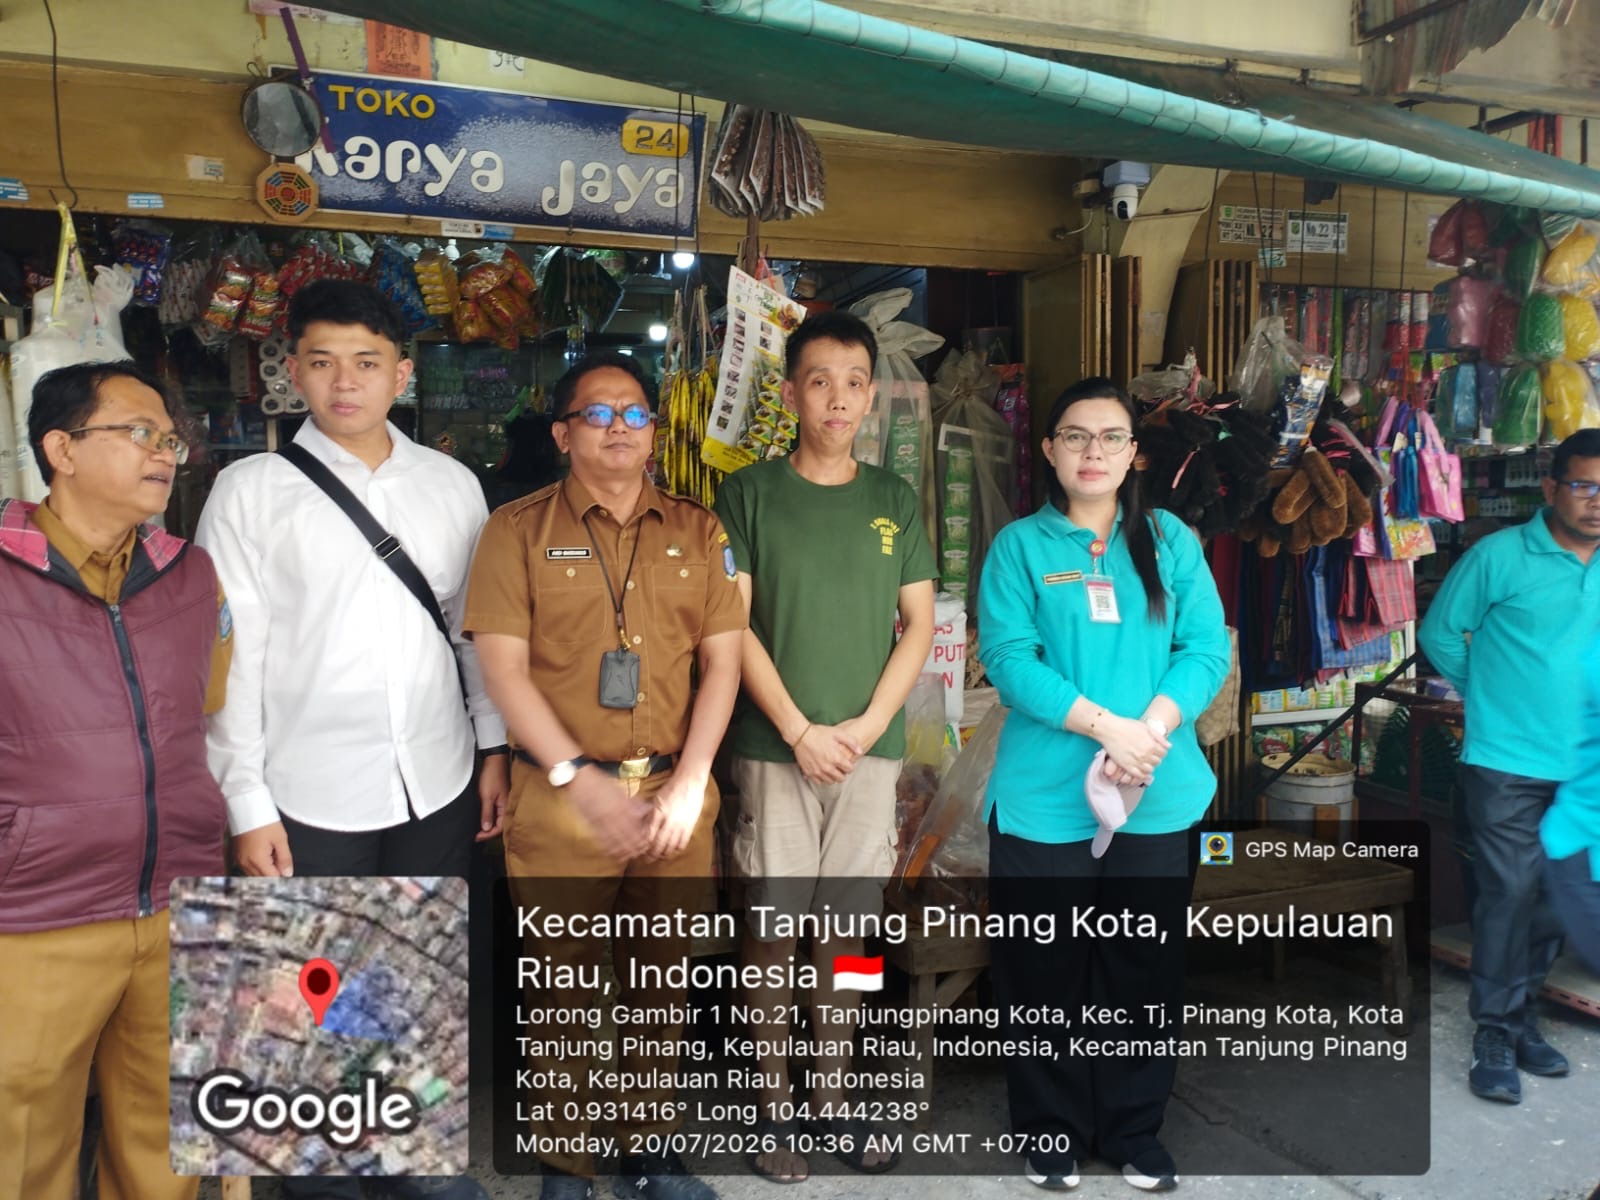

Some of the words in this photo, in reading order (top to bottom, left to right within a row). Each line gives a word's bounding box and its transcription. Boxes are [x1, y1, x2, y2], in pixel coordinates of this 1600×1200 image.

[327, 84, 437, 120] TOKO
[635, 125, 675, 152] 24
[541, 159, 685, 217] Jaya
